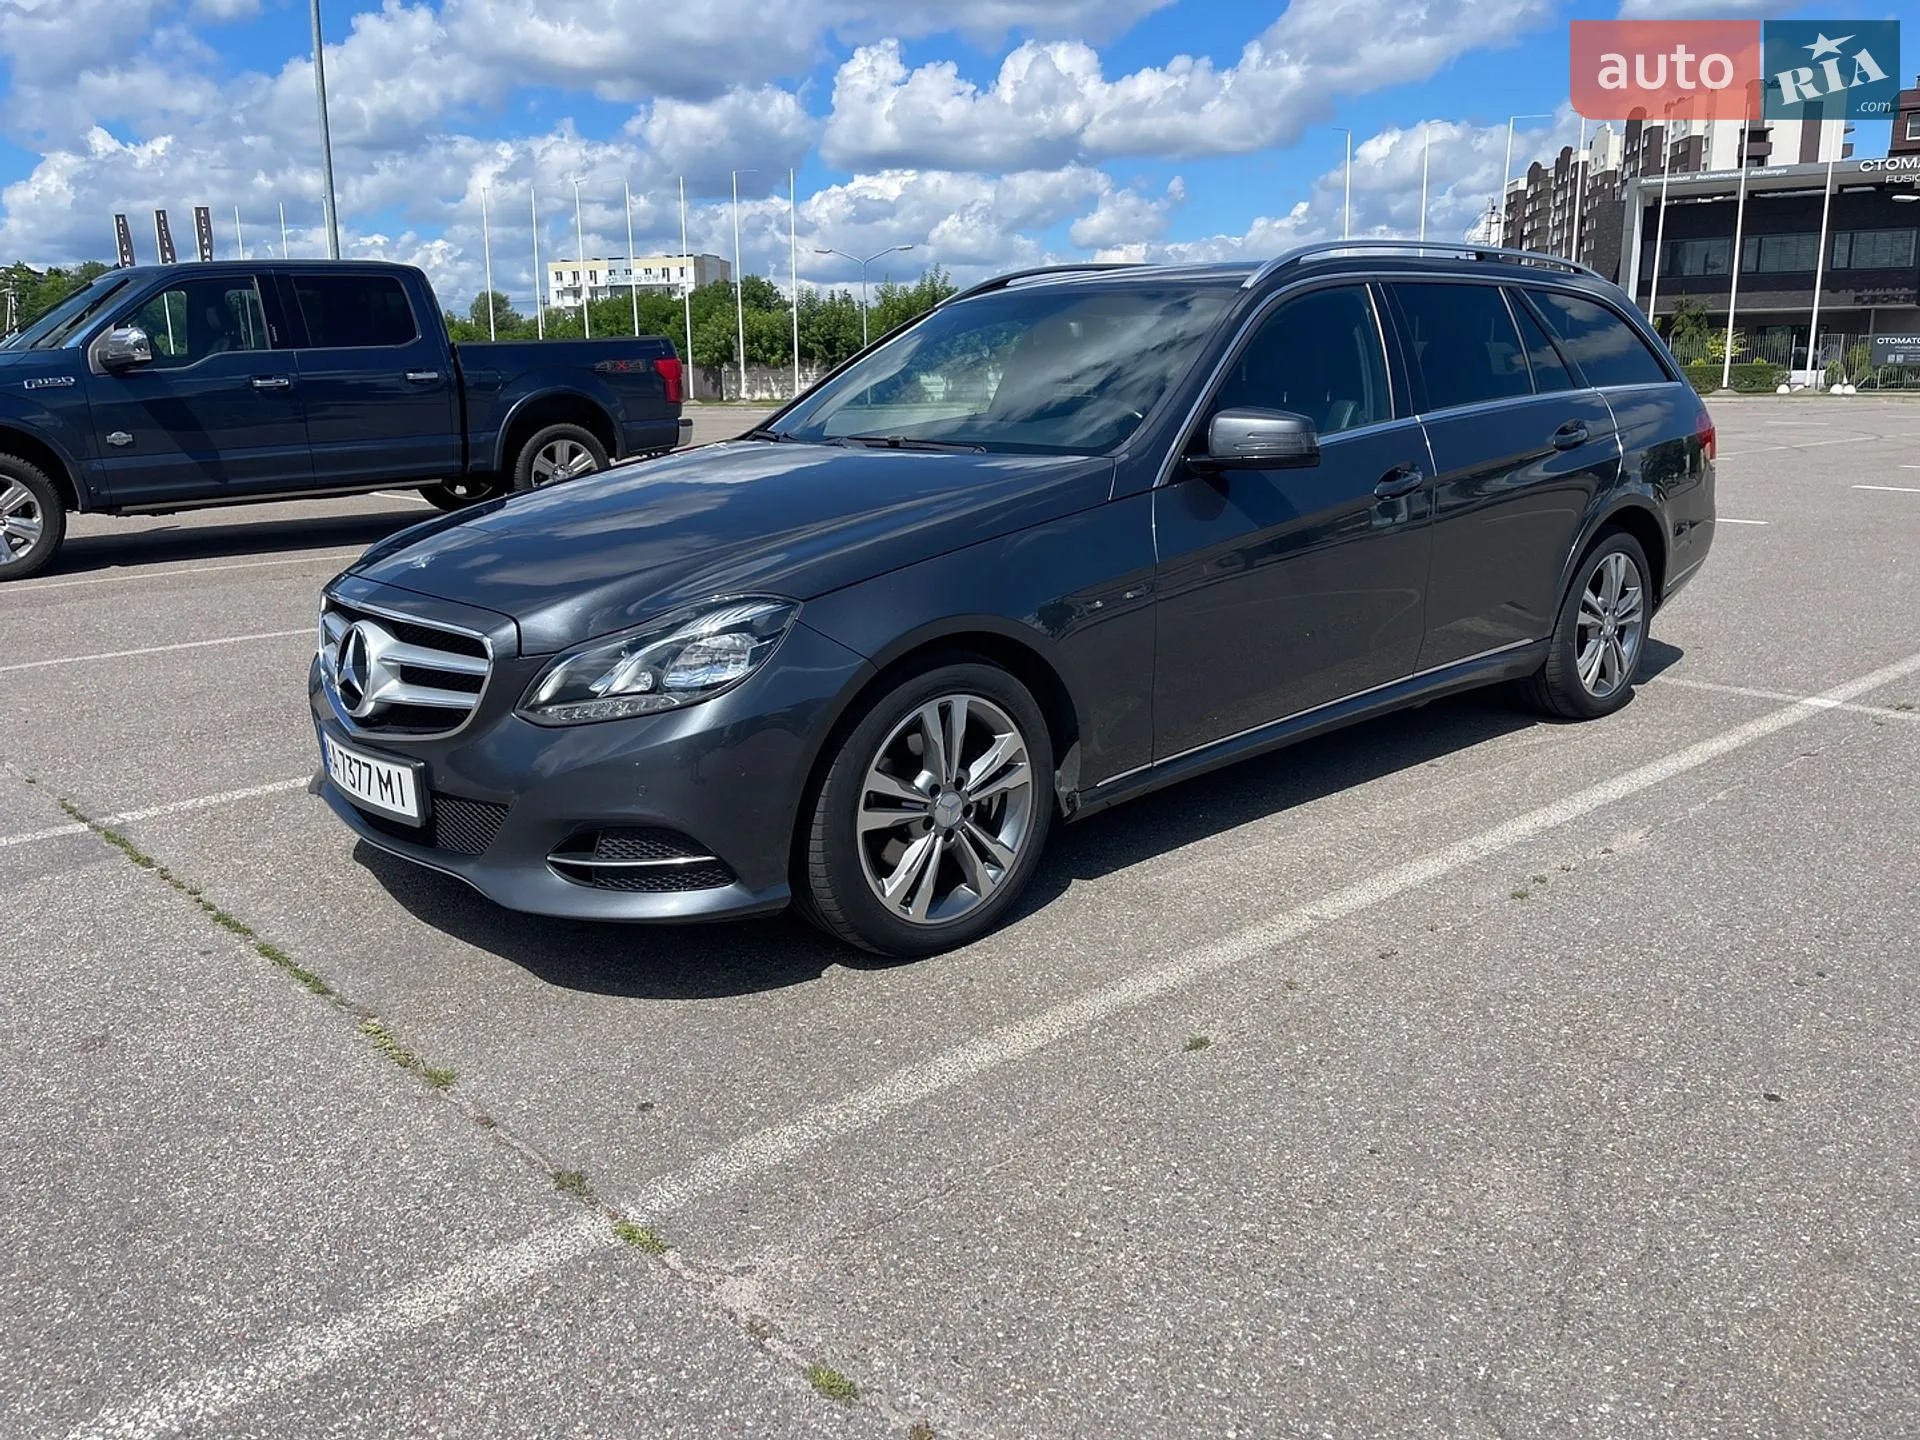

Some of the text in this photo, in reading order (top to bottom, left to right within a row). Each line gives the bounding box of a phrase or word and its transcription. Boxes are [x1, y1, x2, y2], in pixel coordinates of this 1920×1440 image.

[1859, 157, 1920, 171] СТОМ
[338, 750, 372, 796] 7377
[376, 765, 405, 808] MI
